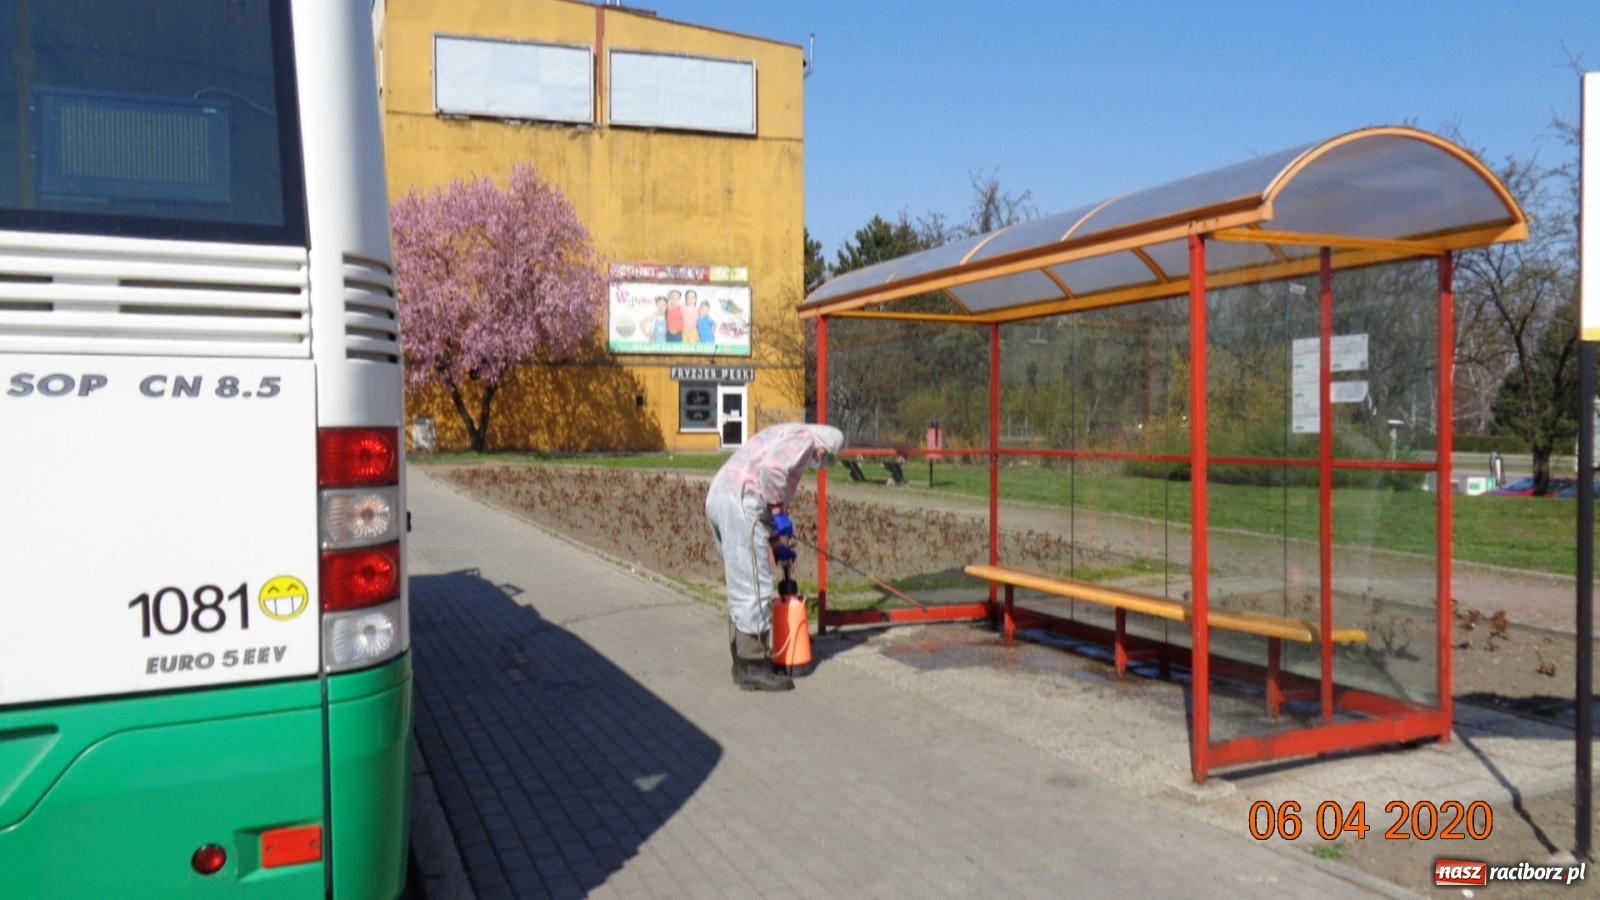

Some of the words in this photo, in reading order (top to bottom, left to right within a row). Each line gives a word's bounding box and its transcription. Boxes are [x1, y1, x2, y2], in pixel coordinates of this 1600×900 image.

[7, 373, 107, 398] SOP
[139, 376, 203, 398] CN
[214, 376, 281, 399] 8.5
[671, 367, 716, 379] FRYZJER
[128, 582, 249, 638] 1081
[145, 649, 215, 675] EURO
[221, 649, 239, 668] 5
[243, 645, 288, 666] EEV
